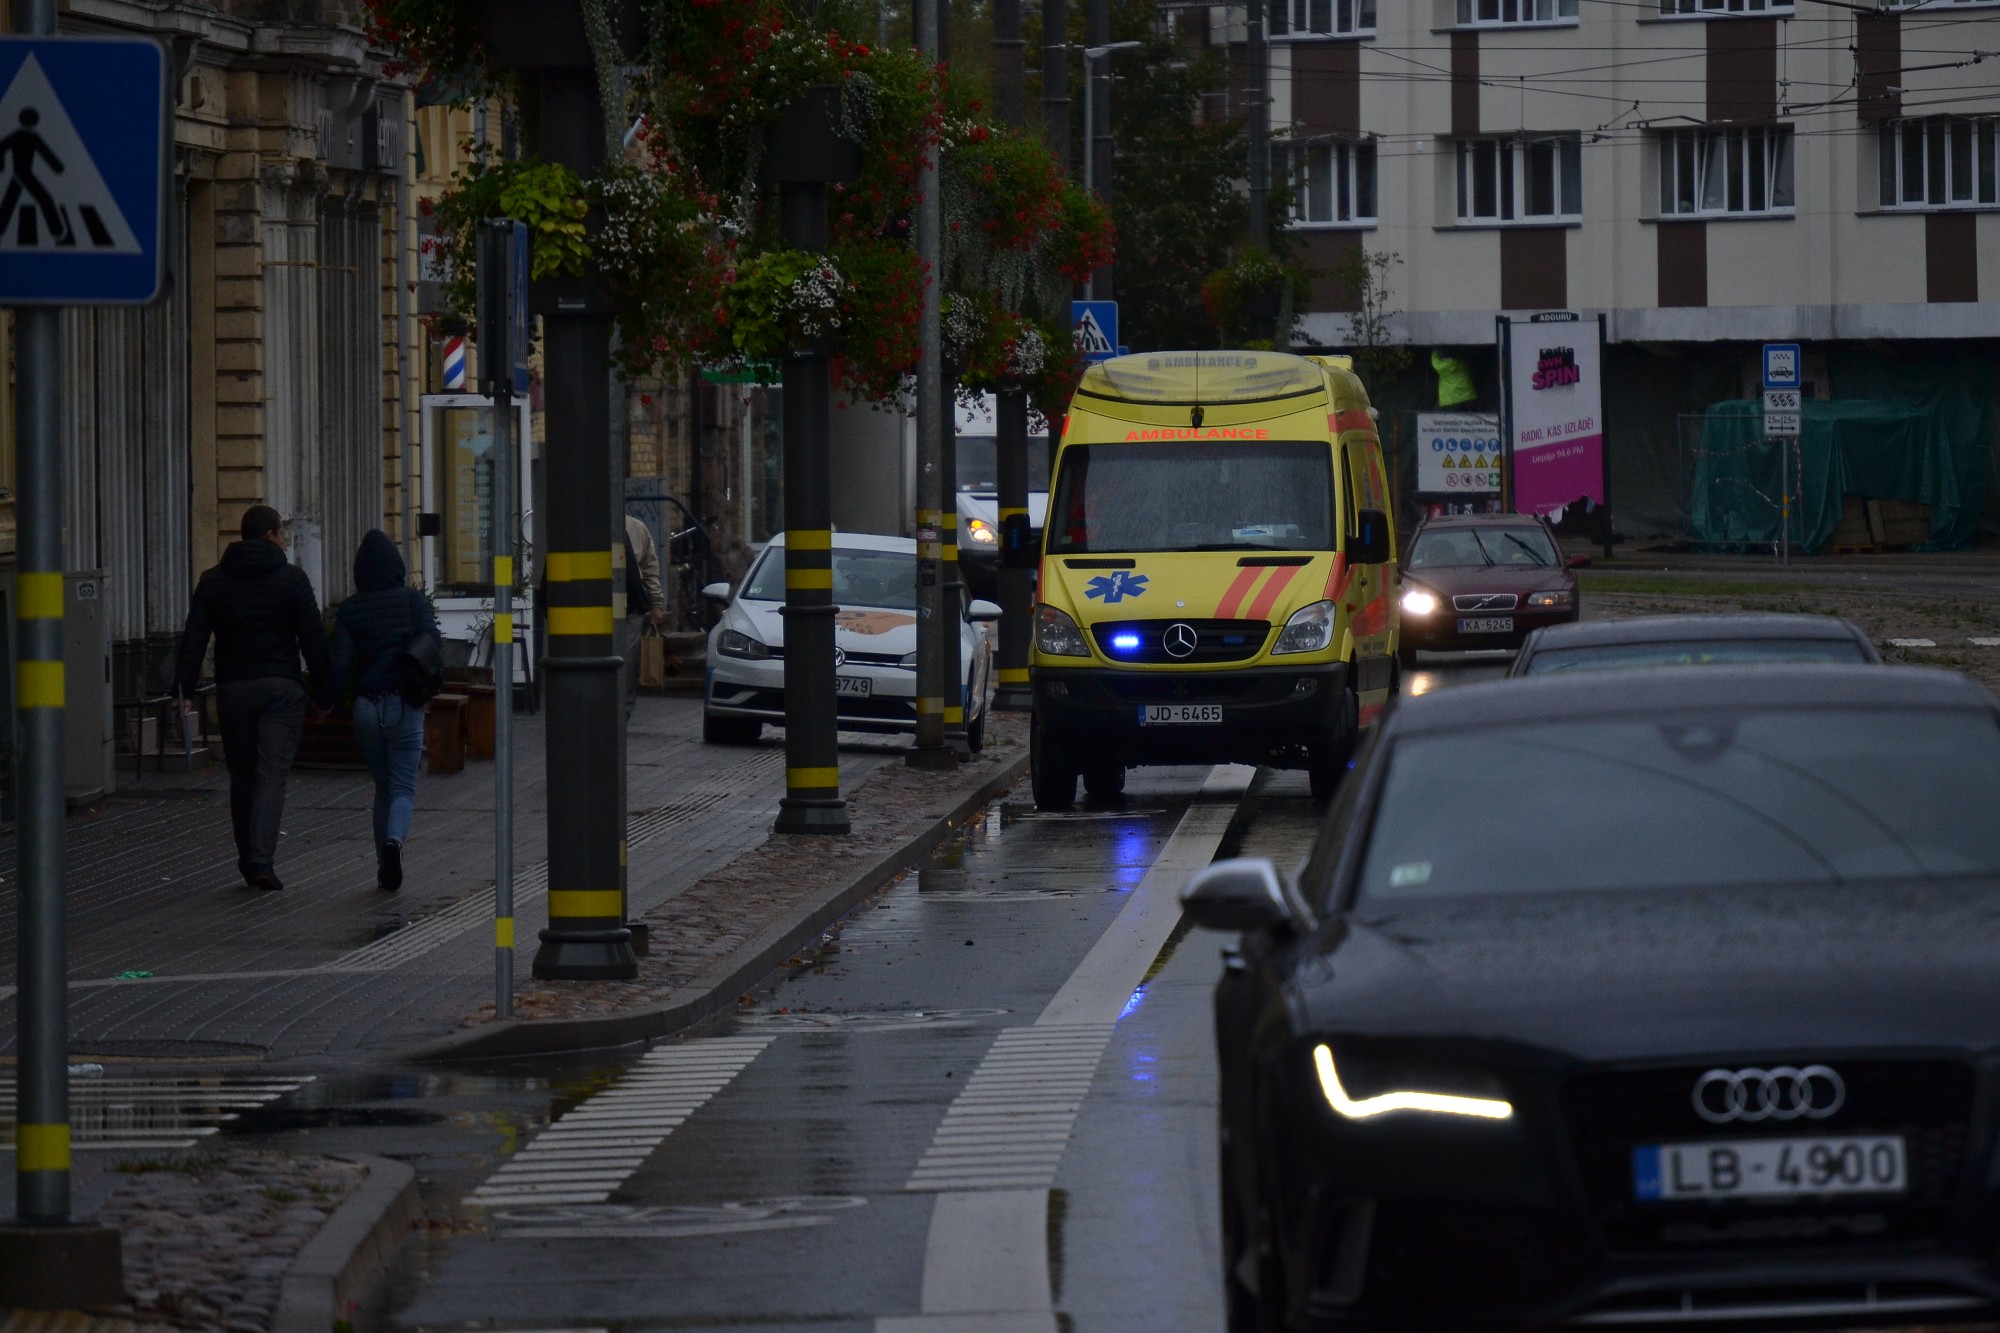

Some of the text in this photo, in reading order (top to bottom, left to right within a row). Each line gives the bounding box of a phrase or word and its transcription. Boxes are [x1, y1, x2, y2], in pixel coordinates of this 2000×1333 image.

[1540, 313, 1572, 321] ADGURU
[1164, 356, 1242, 369] AMBULANCE
[1532, 364, 1580, 391] SPIN
[1125, 427, 1269, 442] AMBULANCE
[1547, 424, 1562, 438] KAS
[1572, 445, 1584, 455] FM
[1465, 619, 1512, 631] KA-5245
[1150, 706, 1220, 721] JD-6465
[1671, 1142, 1897, 1192] LB-4900
